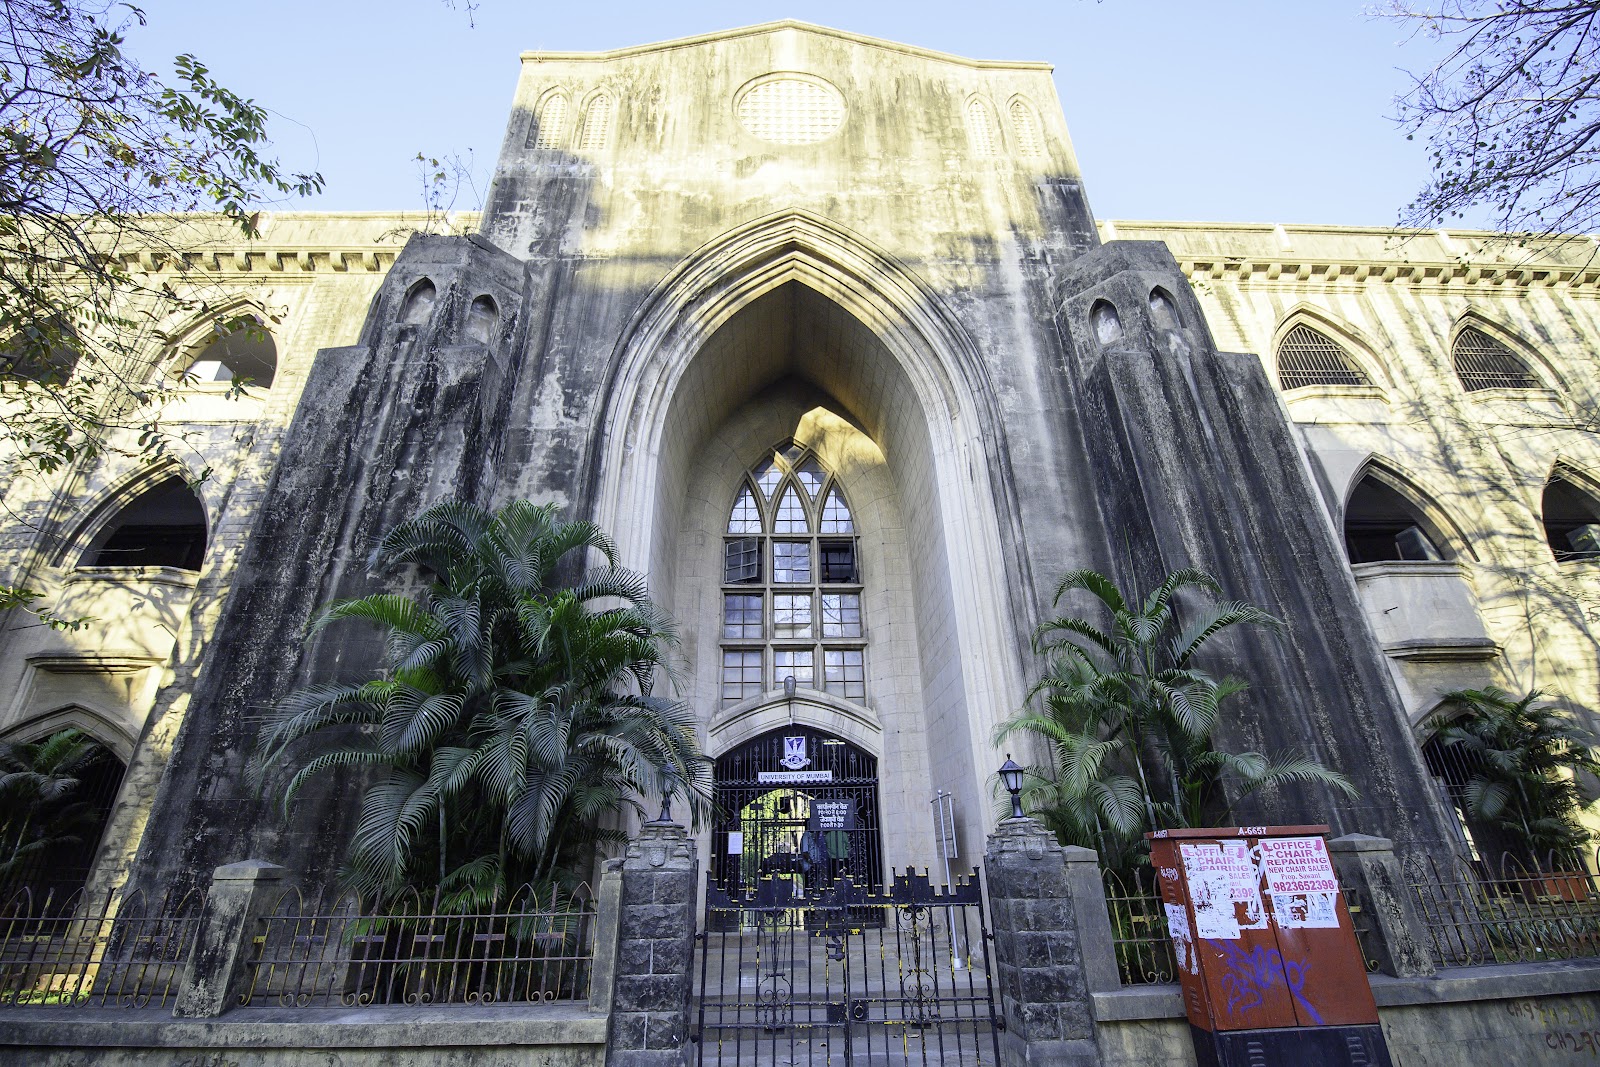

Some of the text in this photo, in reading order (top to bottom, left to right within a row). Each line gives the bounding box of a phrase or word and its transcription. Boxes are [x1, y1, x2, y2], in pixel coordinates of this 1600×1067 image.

[1238, 827, 1267, 836] A-6657
[1272, 841, 1313, 850] OFFICE
[1275, 849, 1314, 858] CHAIR
[1197, 857, 1235, 865] CHAIR
[1266, 857, 1327, 866] REPAIRING
[1285, 865, 1306, 873] CHAIR
[1307, 864, 1330, 872] SALES
[1228, 872, 1251, 880] SALES
[1273, 880, 1335, 892] 9823652398
